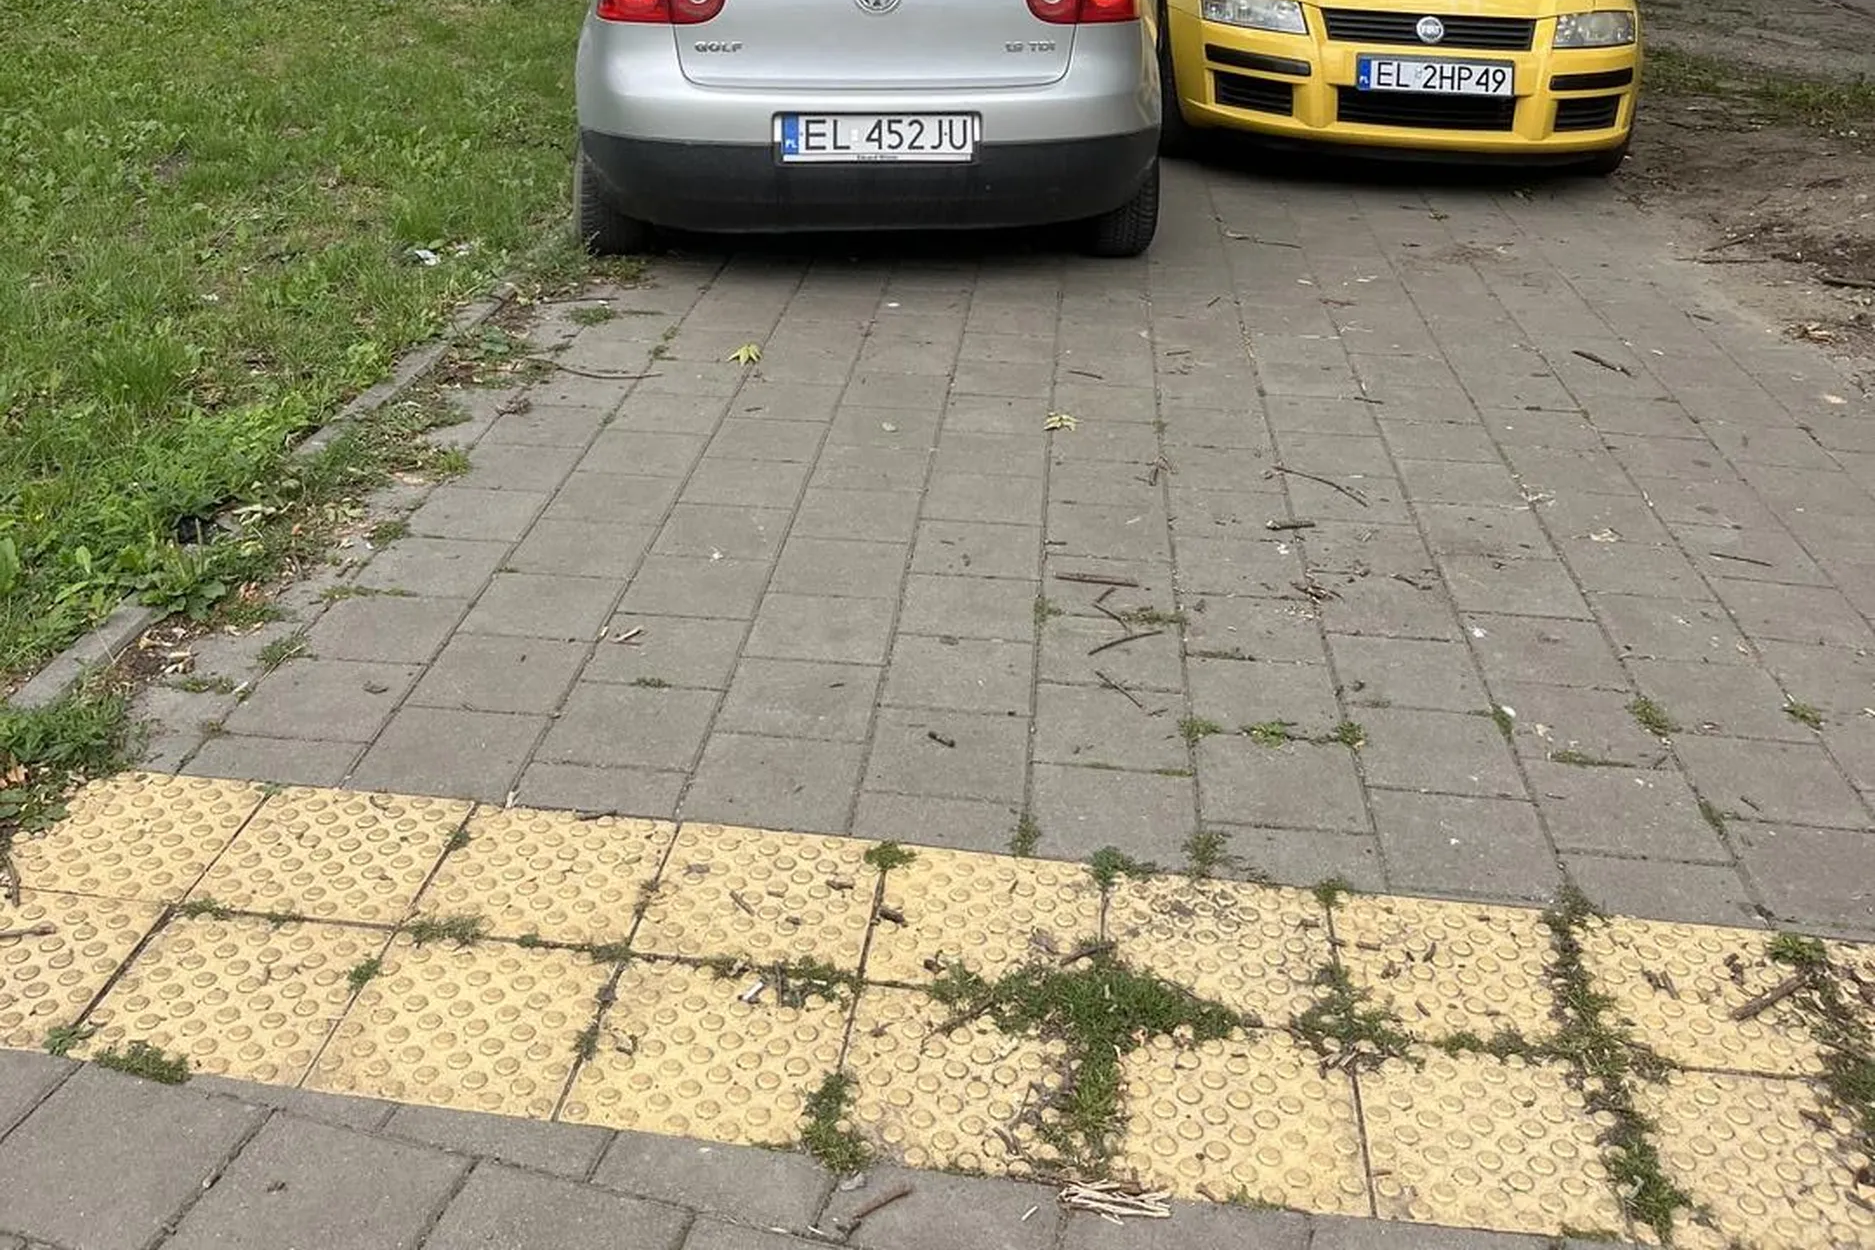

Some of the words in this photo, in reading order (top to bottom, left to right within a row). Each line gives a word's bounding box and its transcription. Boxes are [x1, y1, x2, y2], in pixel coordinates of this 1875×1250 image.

[694, 40, 743, 53] GOLF
[1377, 62, 1410, 88] EL
[1423, 64, 1506, 93] 2HP49
[805, 119, 850, 150] EL
[865, 118, 968, 151] 452JU
